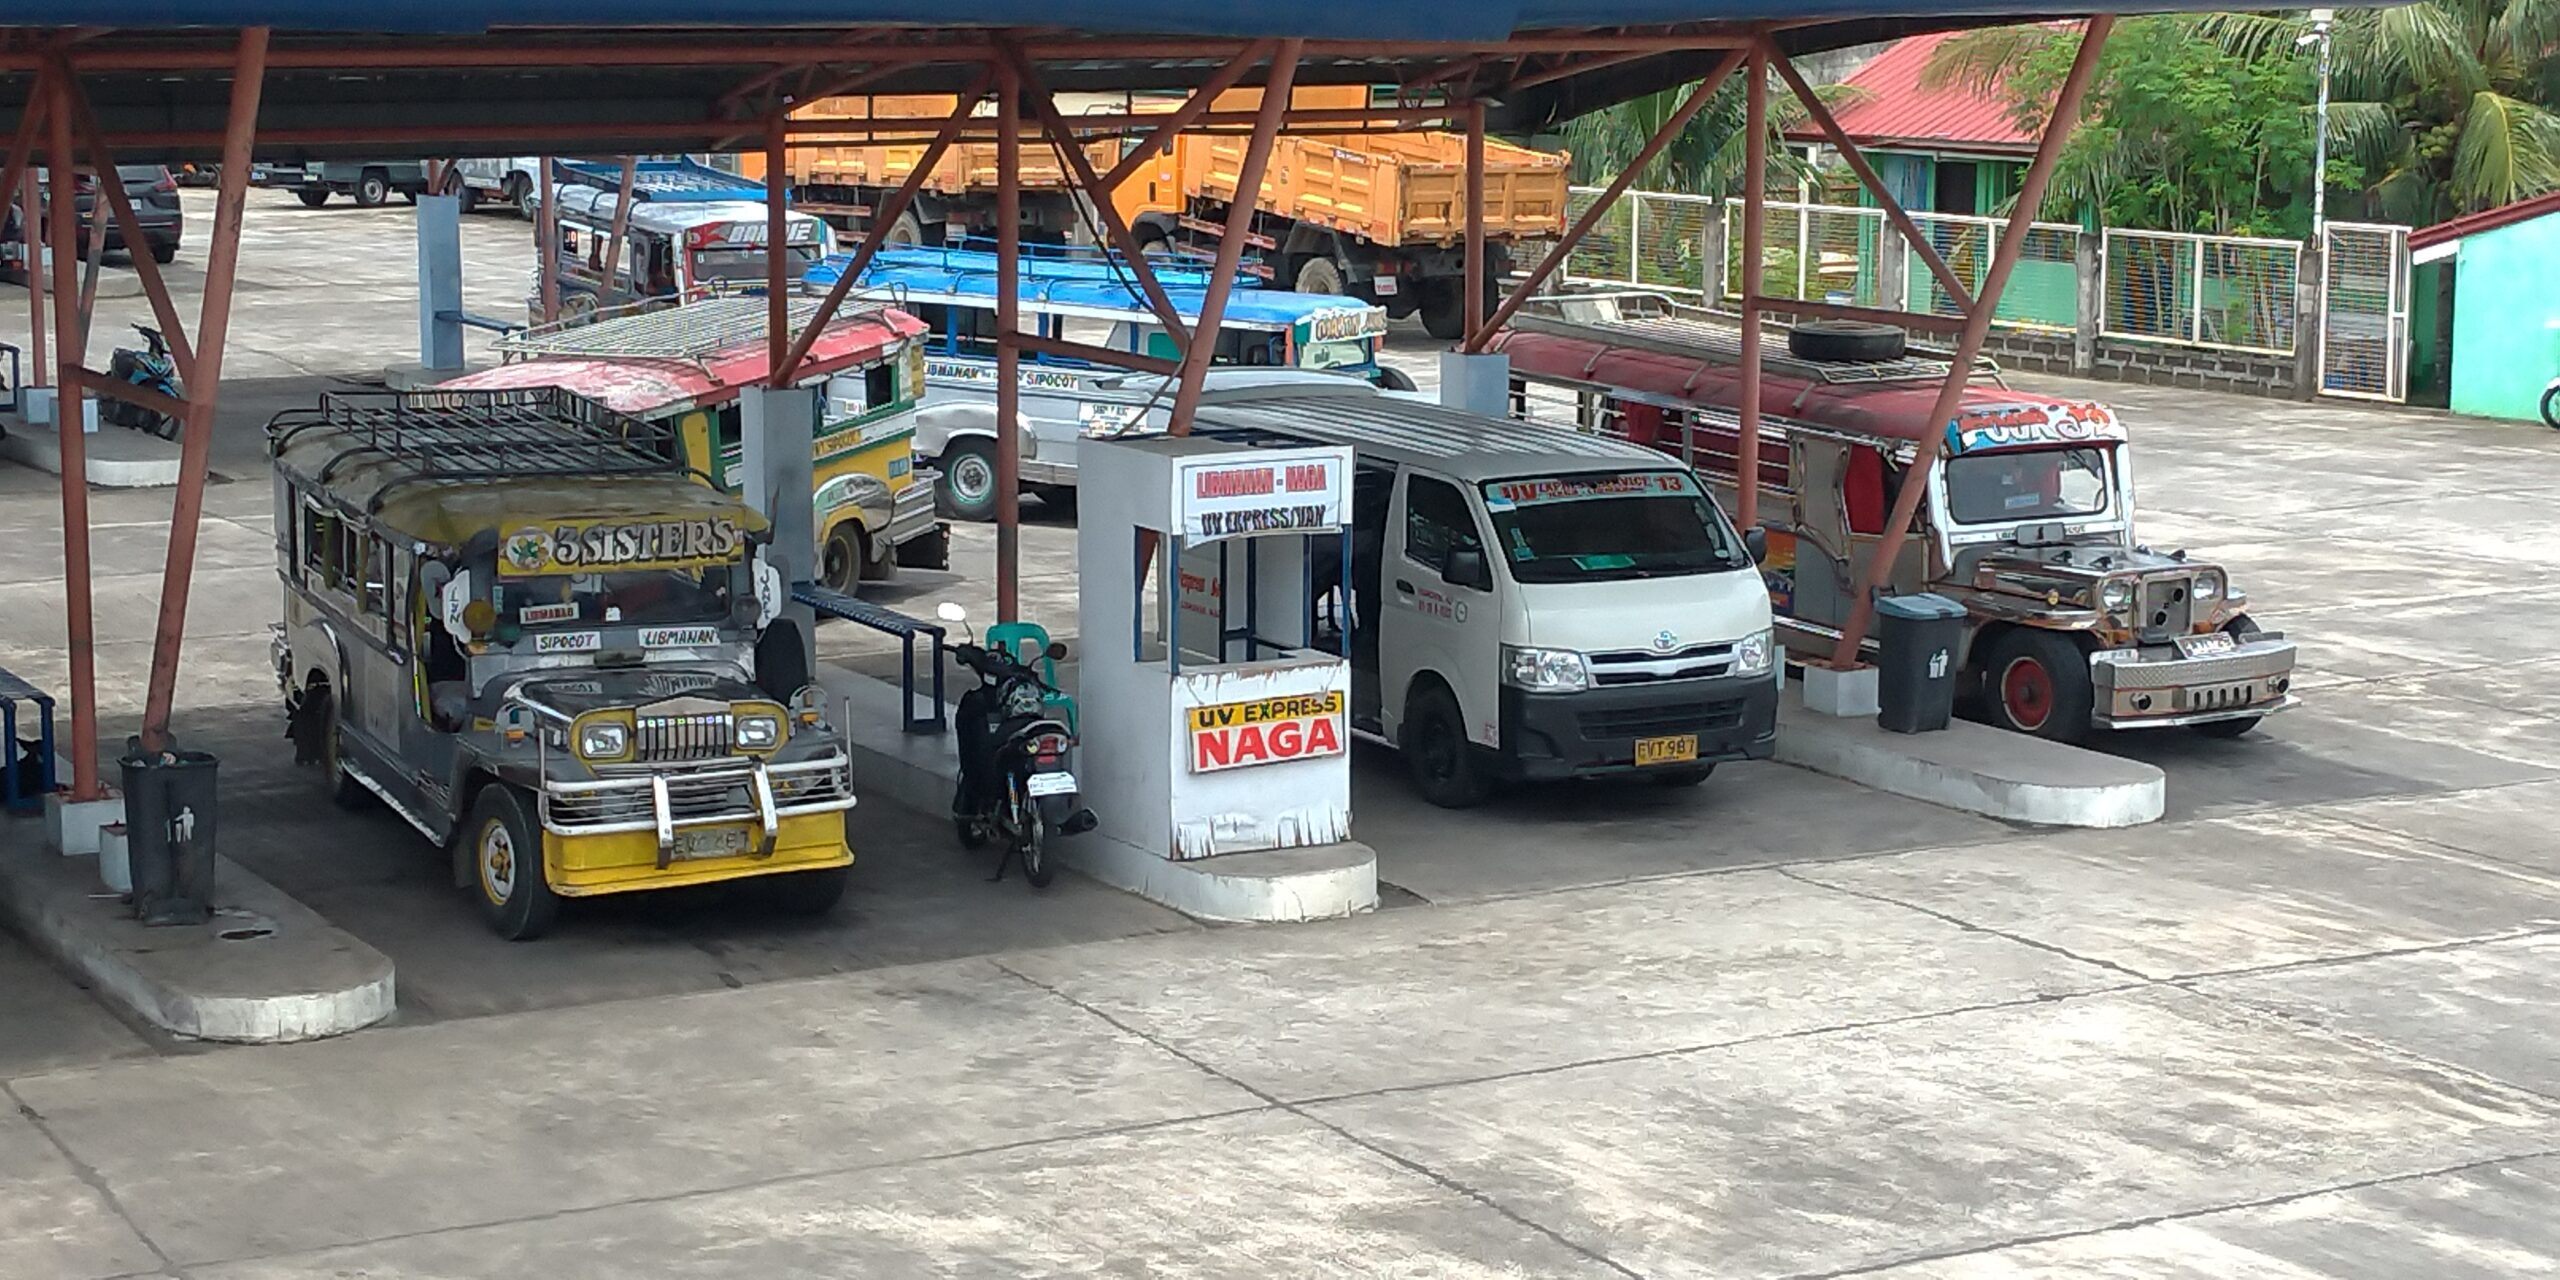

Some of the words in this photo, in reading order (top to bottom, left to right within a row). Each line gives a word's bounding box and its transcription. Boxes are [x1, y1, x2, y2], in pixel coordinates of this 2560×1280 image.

[1197, 467, 1274, 498] LIBMANAN
[1286, 464, 1327, 492] NAGA
[1202, 511, 1223, 536] UV
[540, 633, 595, 650] SIPOCOT
[645, 628, 715, 646] LIBMANAN
[1199, 707, 1234, 728] UV
[1244, 696, 1338, 723] EXPRESS
[1198, 717, 1339, 769] NAGA
